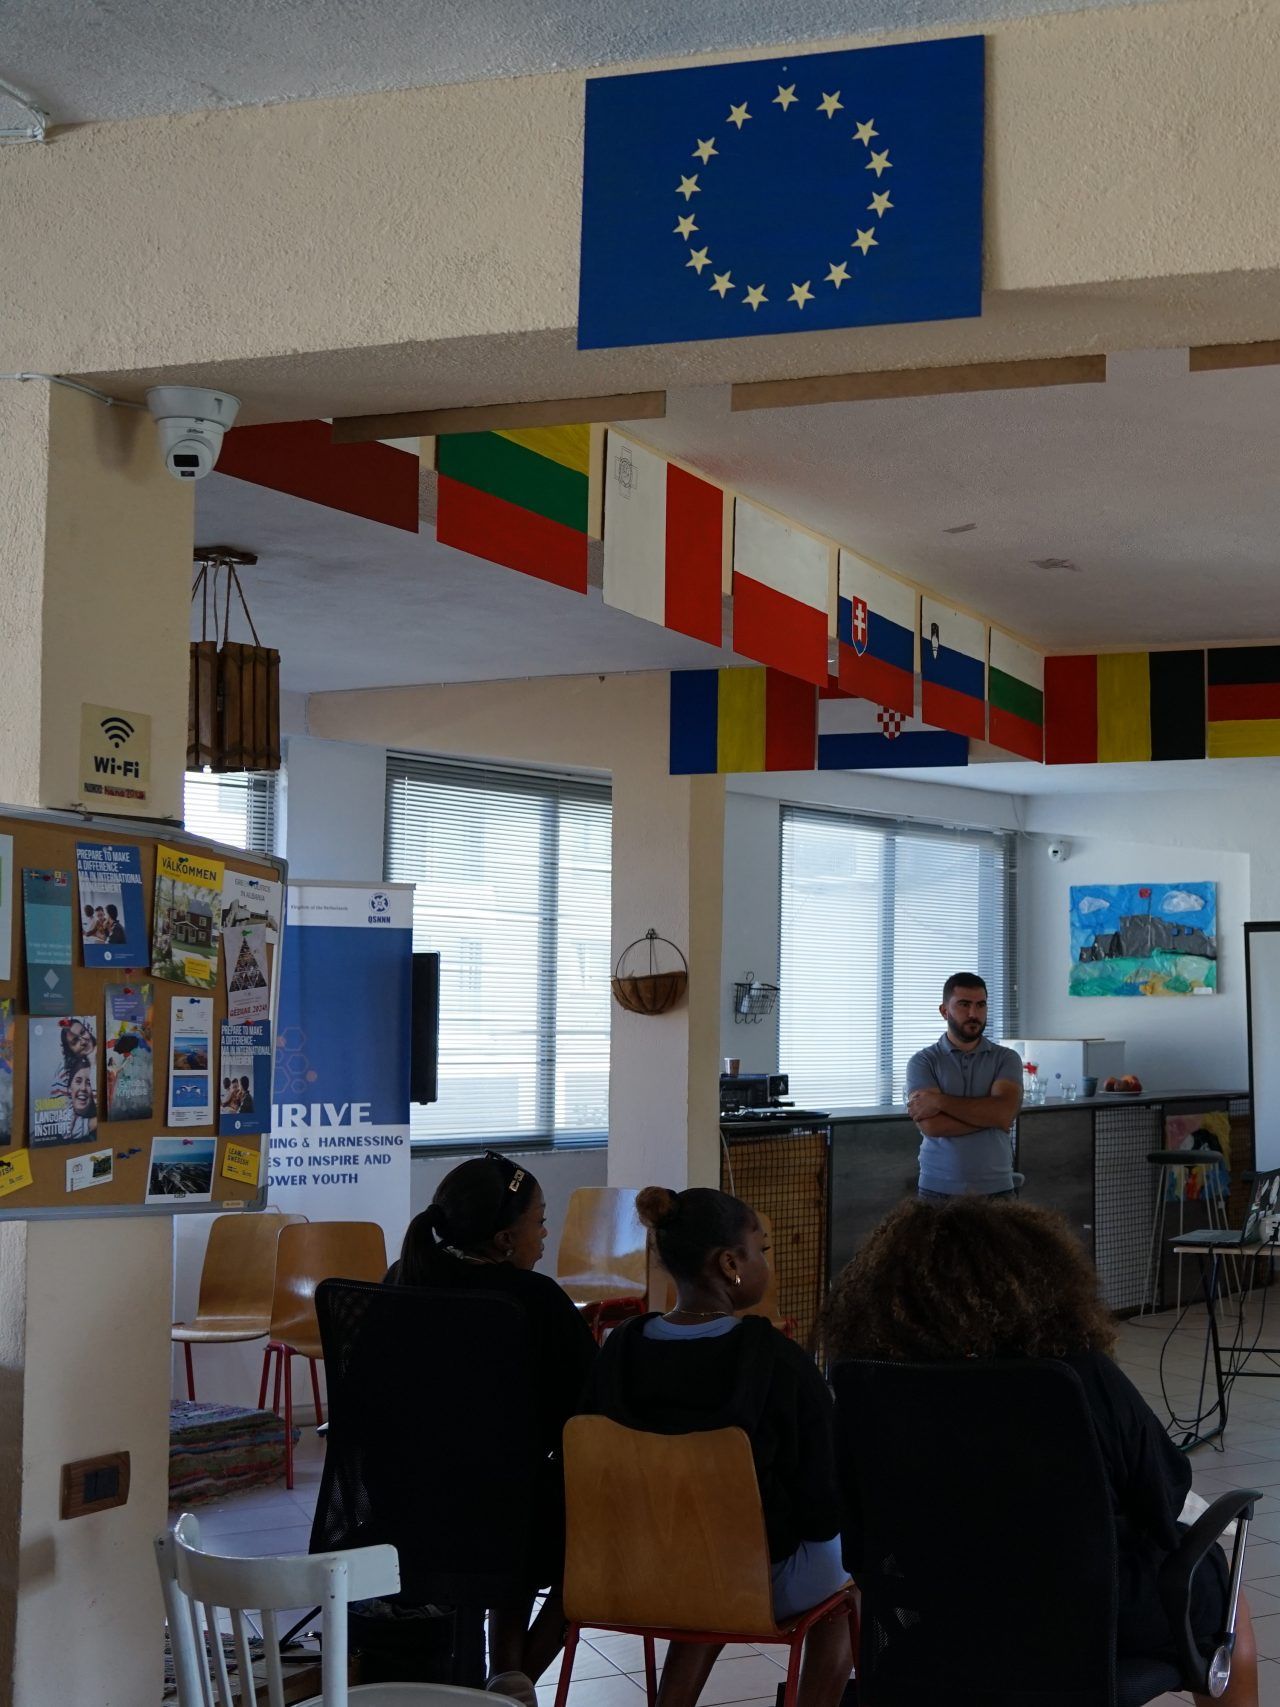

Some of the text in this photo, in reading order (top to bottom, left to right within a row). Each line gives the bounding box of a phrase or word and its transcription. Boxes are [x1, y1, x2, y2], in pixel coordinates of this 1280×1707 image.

[94, 755, 139, 778] Wi-Fi
[77, 849, 131, 862] PREPARE TO MAKE
[78, 860, 82, 870] A
[83, 860, 119, 872] DIFFERENCE
[162, 856, 217, 881] VÄLKOMMEN
[222, 1025, 263, 1036] PREPARE TO MAKE
[226, 1036, 253, 1046] DIFFERENCE
[35, 1109, 72, 1124] LANGUAGE
[35, 1122, 71, 1137] INSTITUTE
[302, 1137, 310, 1148] &
[319, 1135, 403, 1148] HARNESSING
[286, 1156, 304, 1167] TO
[308, 1155, 359, 1167] INSPIRE
[364, 1153, 391, 1165] AND
[312, 1173, 358, 1185] YOUTH
